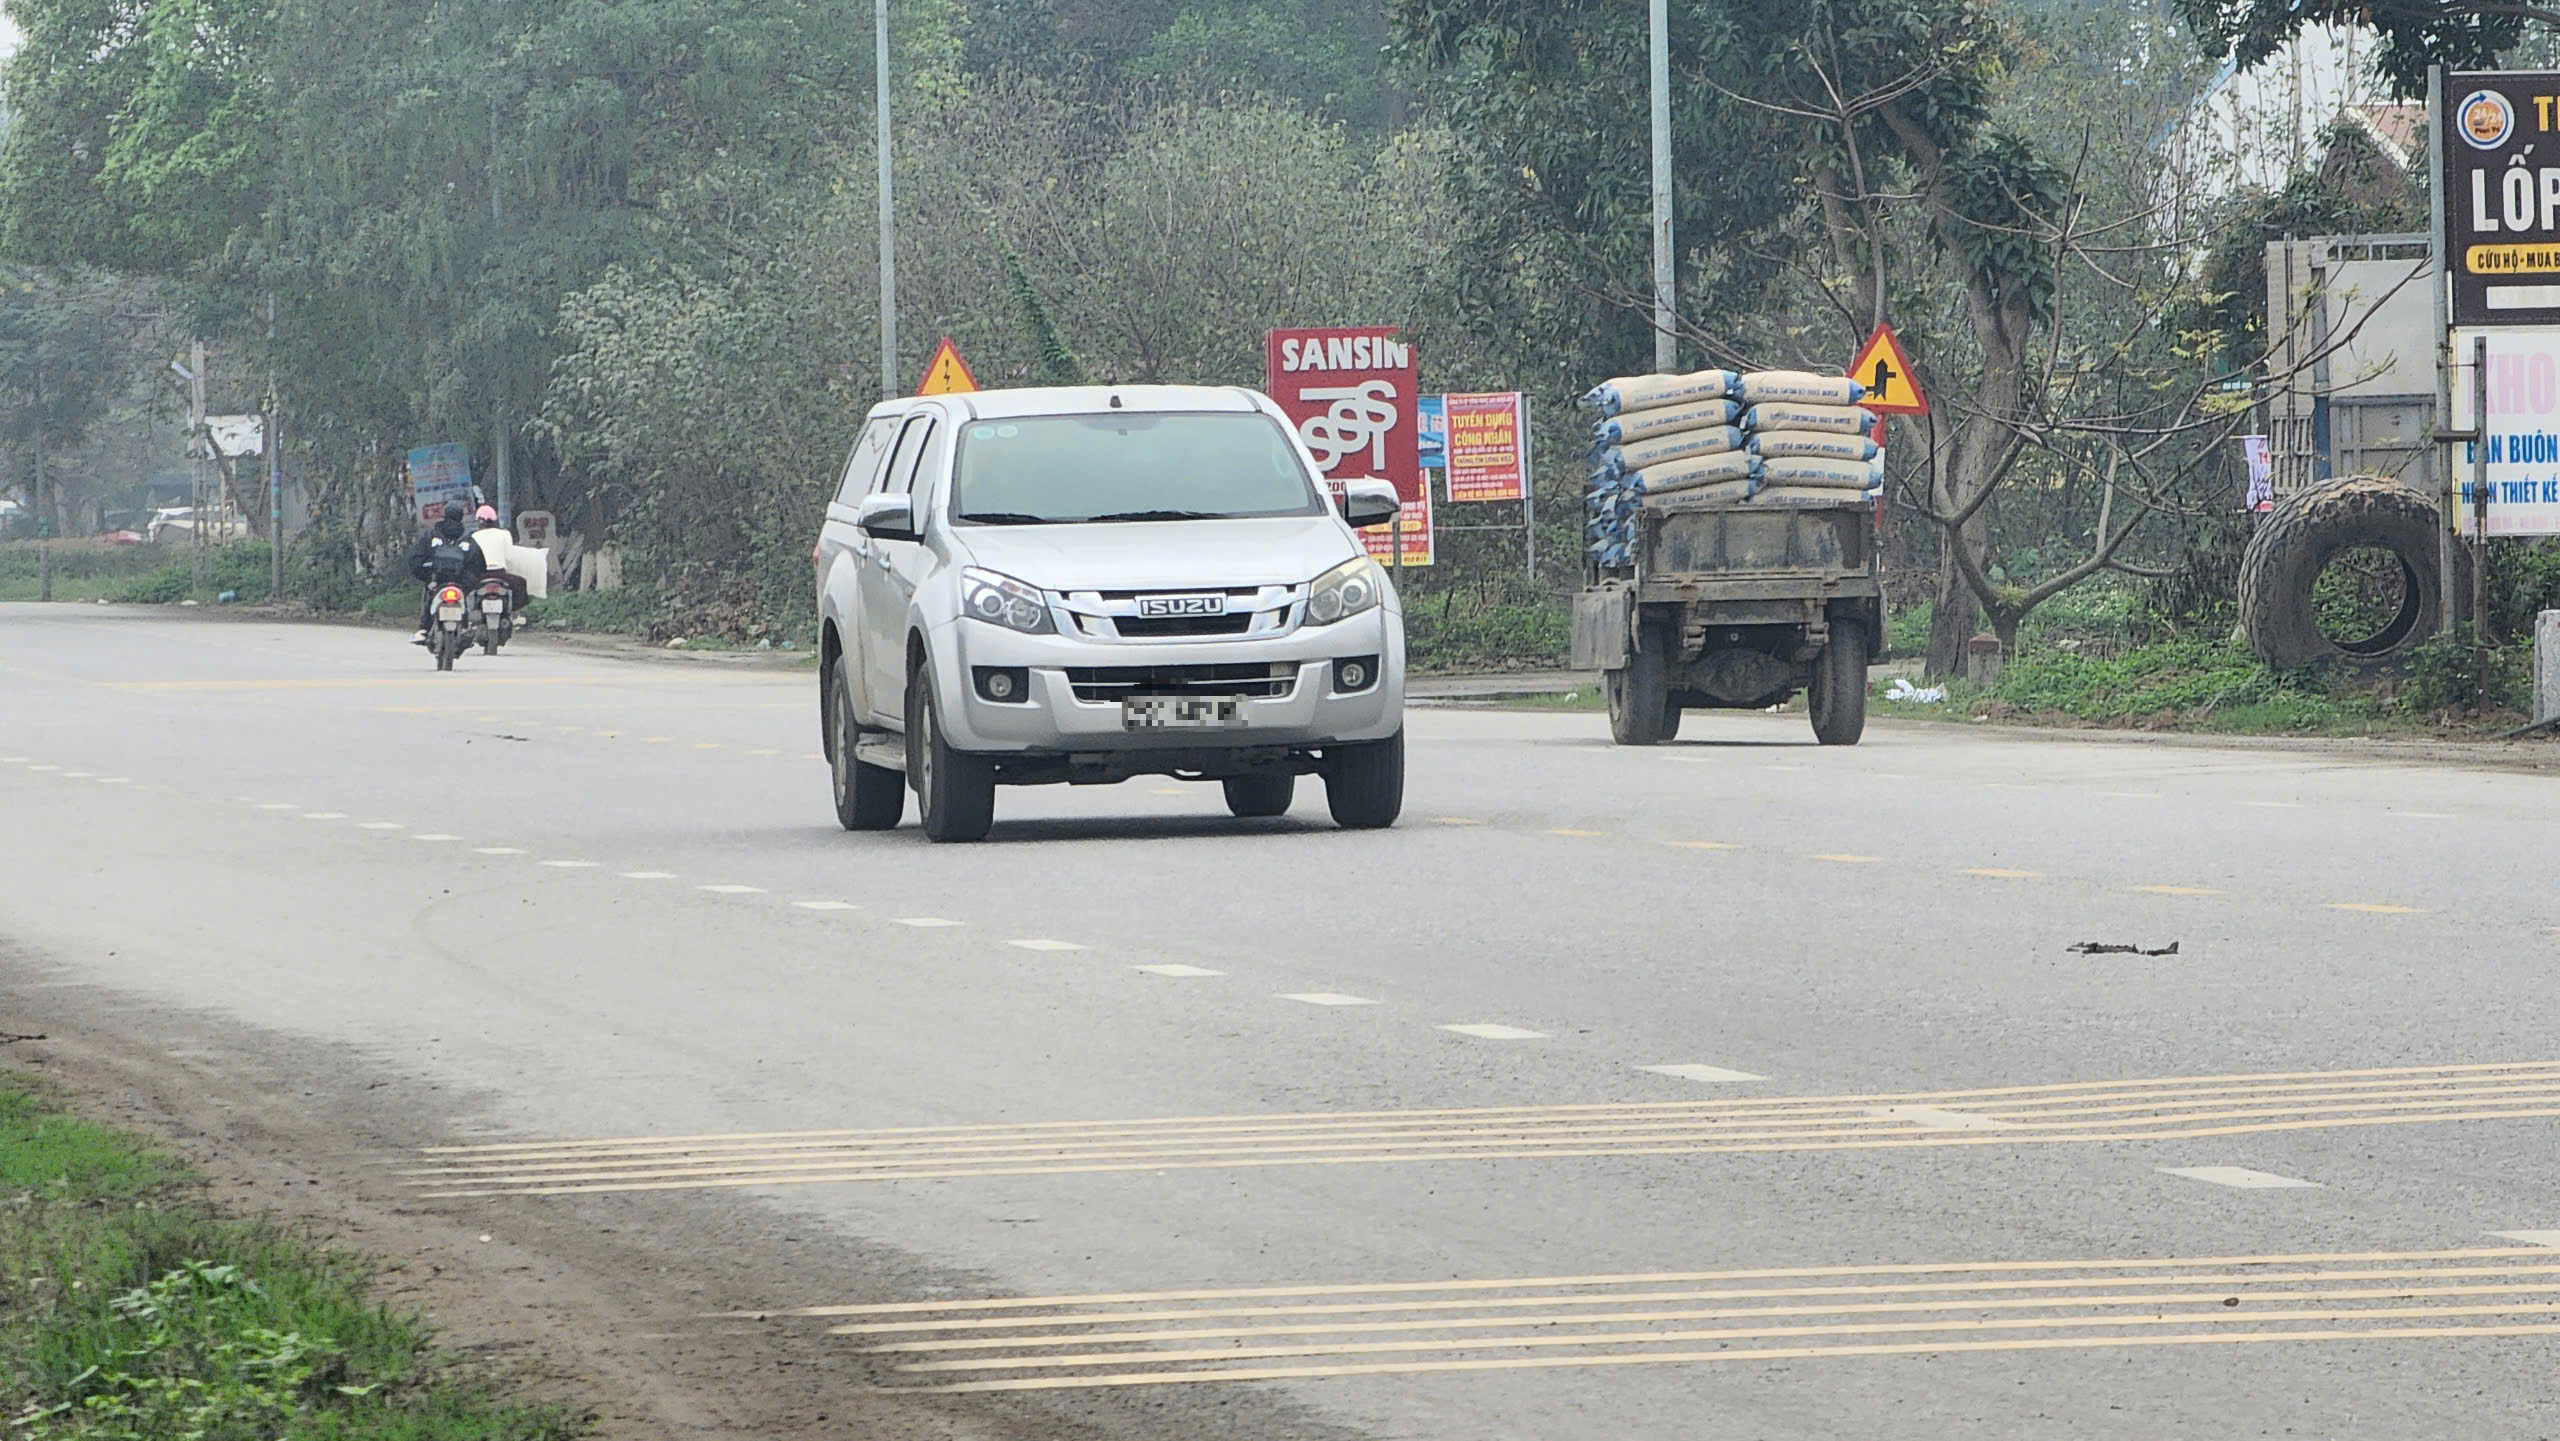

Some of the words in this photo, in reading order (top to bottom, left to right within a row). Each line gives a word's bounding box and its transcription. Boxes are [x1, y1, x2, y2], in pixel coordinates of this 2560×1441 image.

[2472, 144, 2560, 231] LỐP
[1282, 336, 1408, 371] SANSIN
[2509, 429, 2558, 464] BUÔN
[1142, 598, 1221, 615] ISUZU
